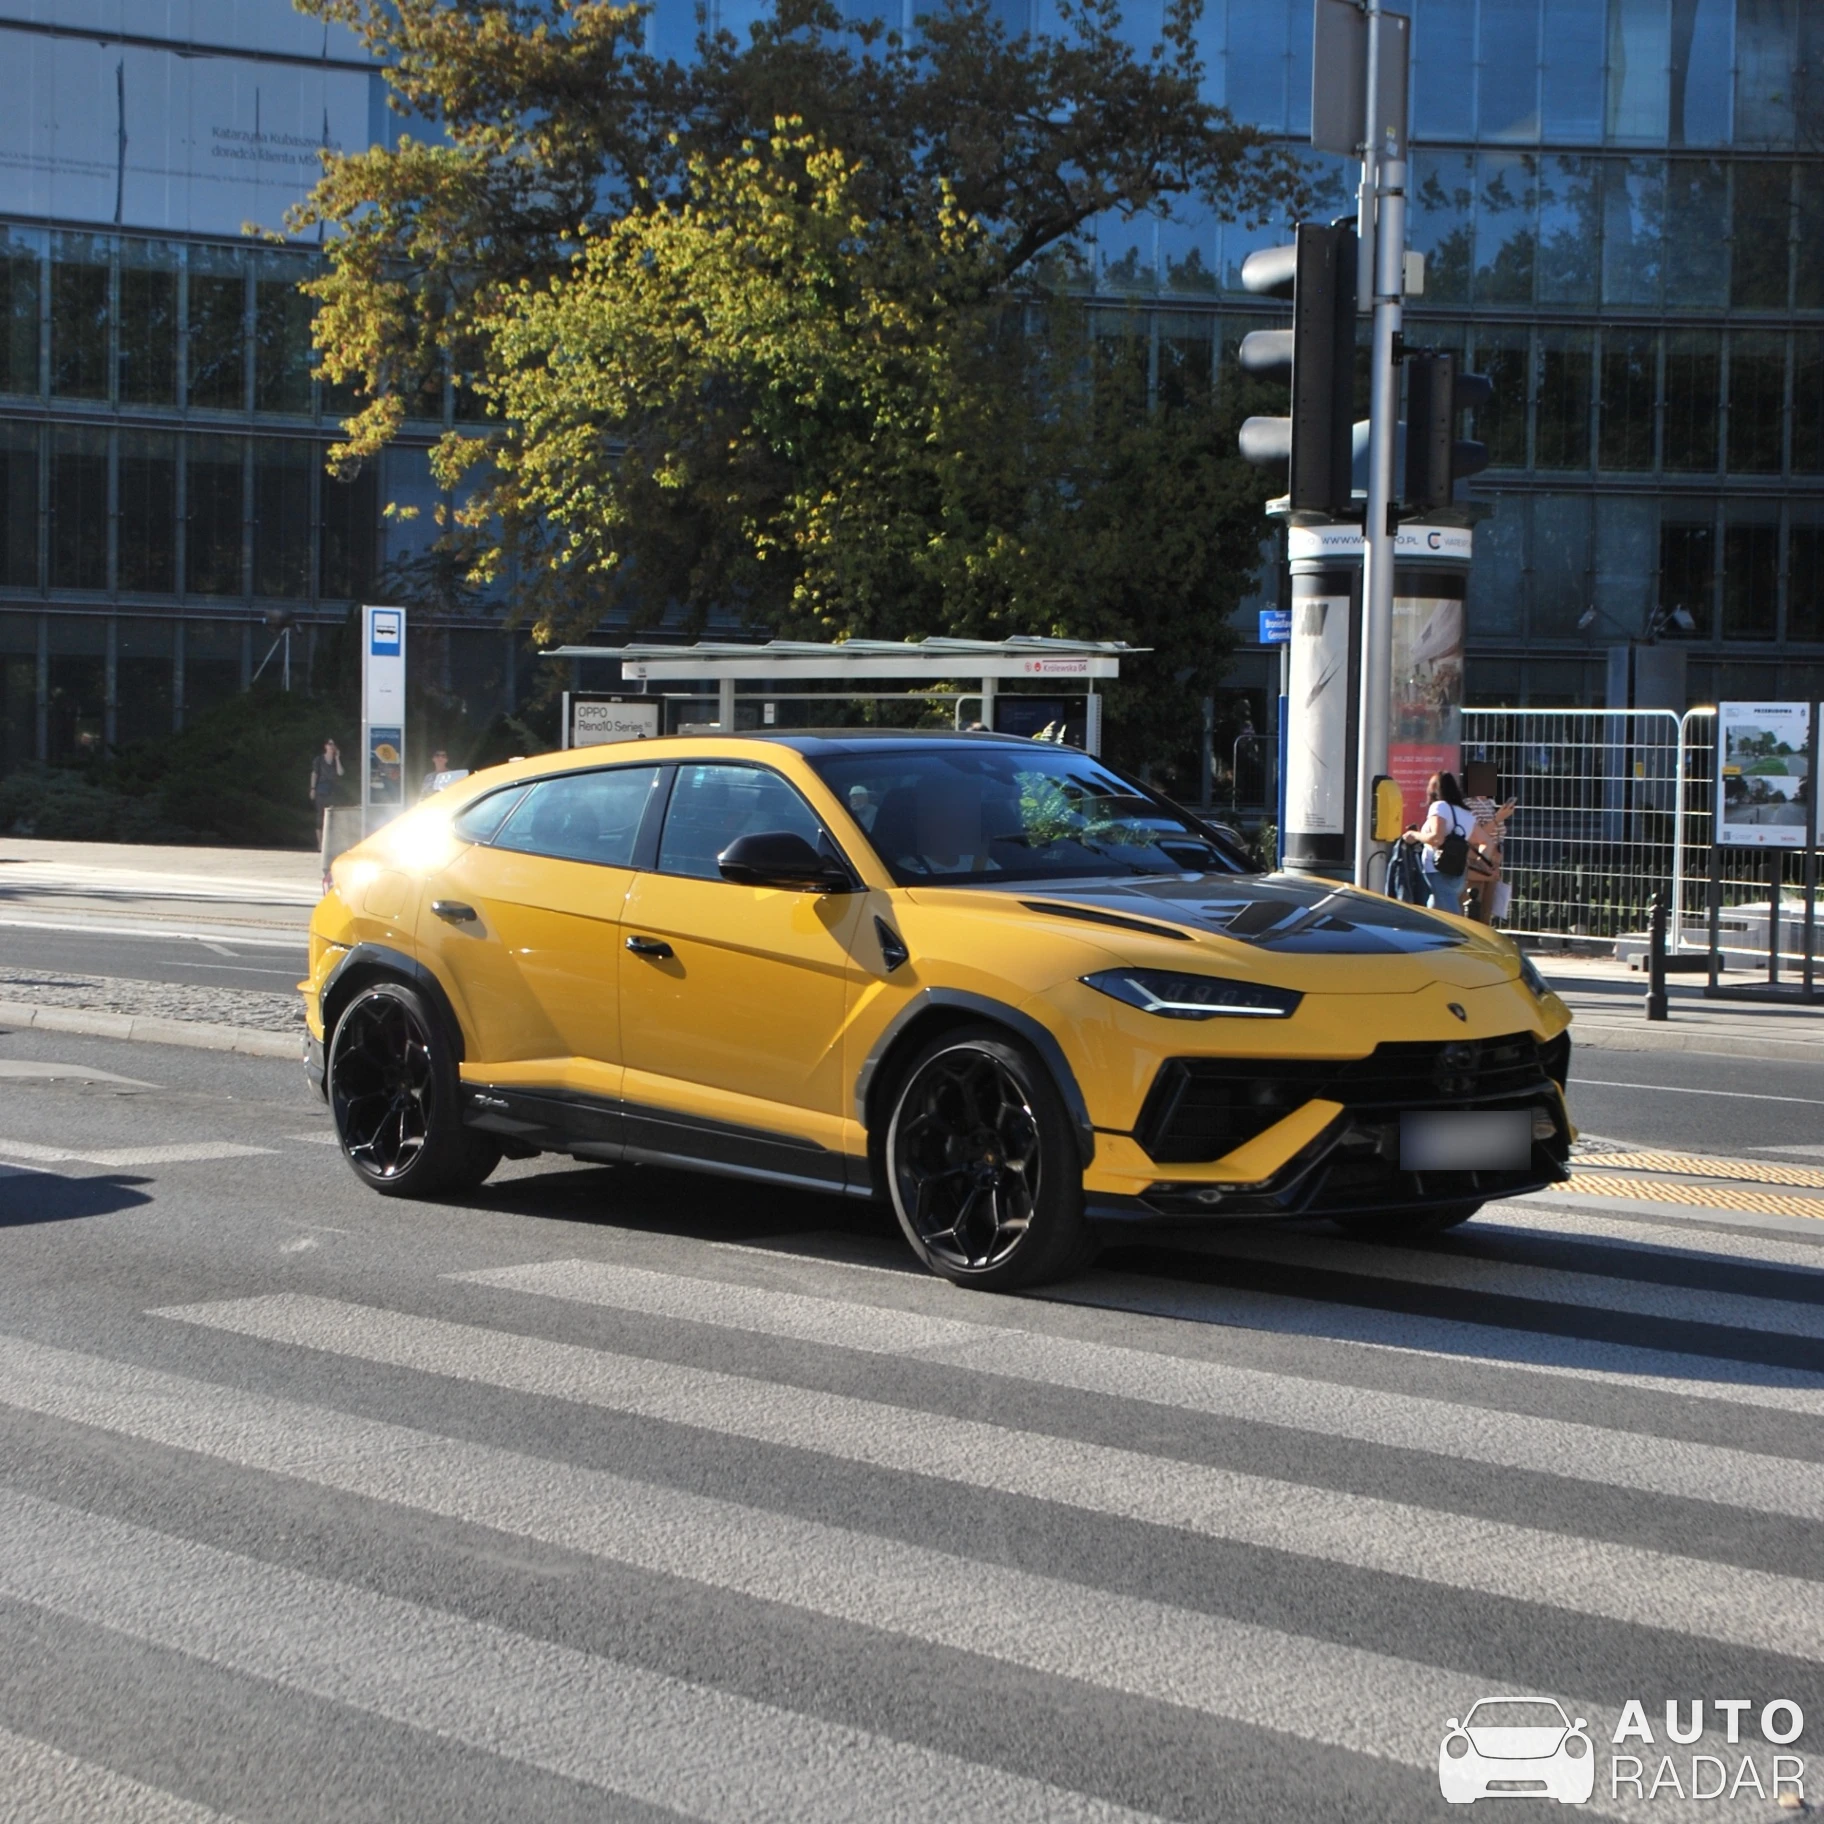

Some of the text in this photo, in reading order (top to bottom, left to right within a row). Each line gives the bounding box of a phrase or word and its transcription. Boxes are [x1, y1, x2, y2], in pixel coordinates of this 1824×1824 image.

[578, 706, 608, 718] OPPO
[579, 720, 612, 732] Reno10
[614, 721, 643, 732] Series
